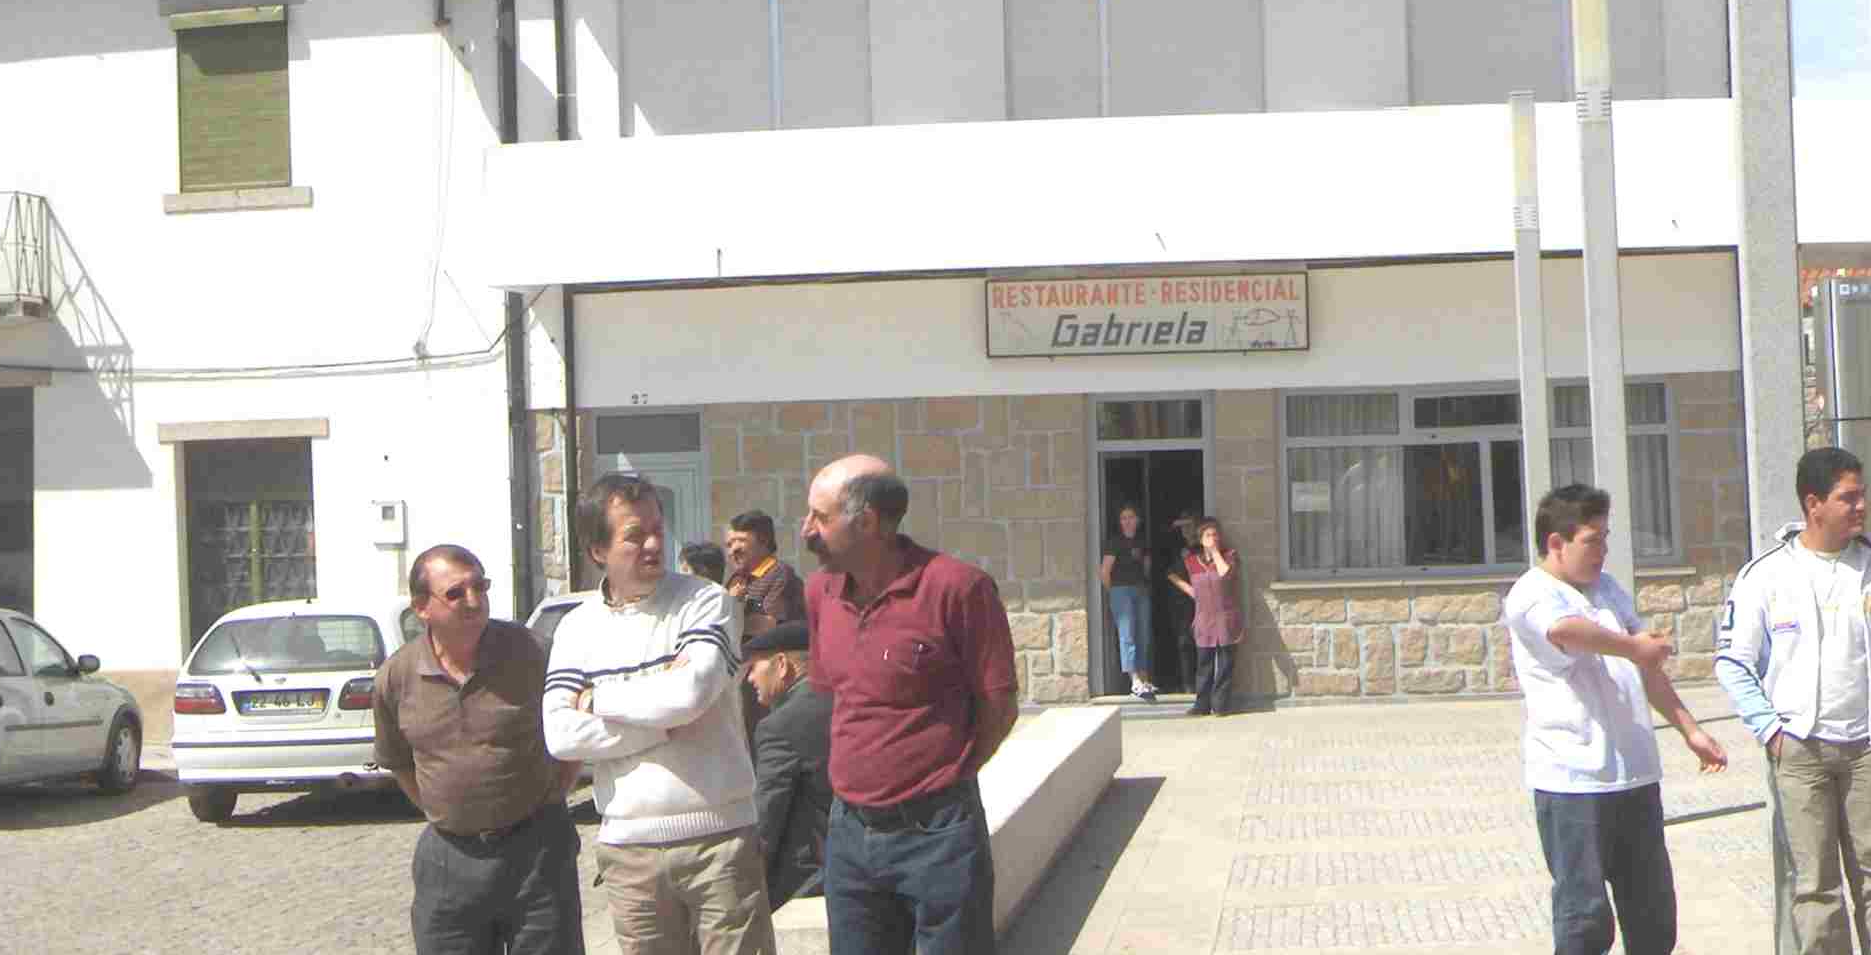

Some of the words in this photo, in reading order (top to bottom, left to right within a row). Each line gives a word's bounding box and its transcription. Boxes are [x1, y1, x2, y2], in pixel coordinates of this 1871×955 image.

[991, 283, 1147, 309] RESTAURANTE
[1160, 279, 1300, 305] RESIDENCIAL
[1051, 312, 1209, 348] Gabriela
